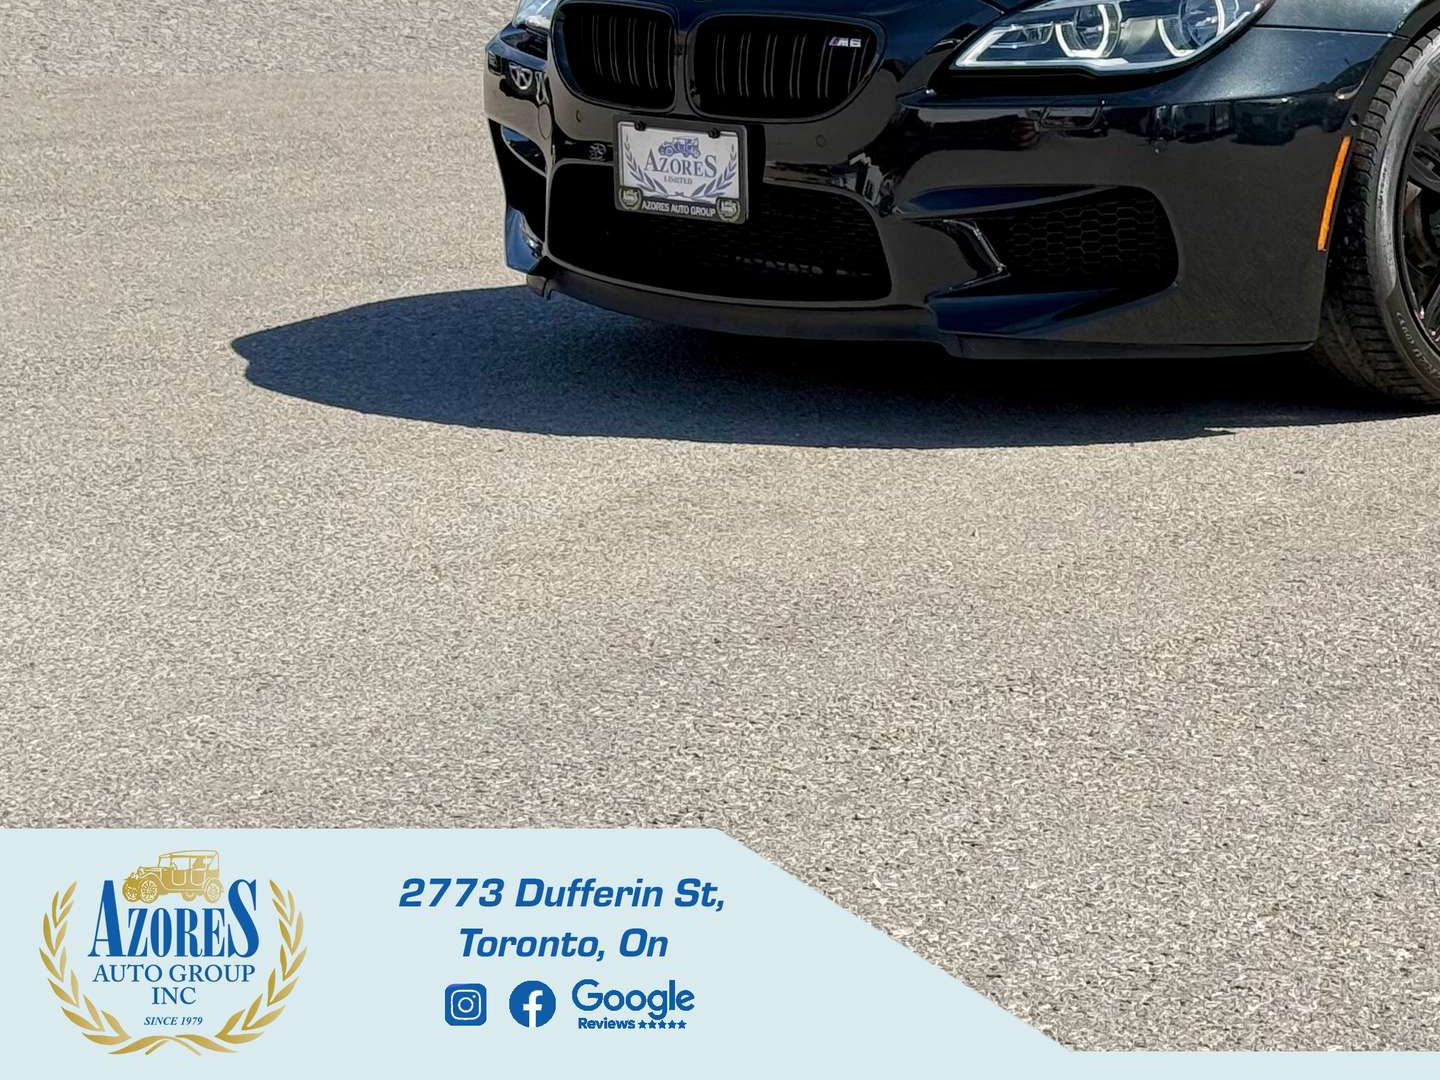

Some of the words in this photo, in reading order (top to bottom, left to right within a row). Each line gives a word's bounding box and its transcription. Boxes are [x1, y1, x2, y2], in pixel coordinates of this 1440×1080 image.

[644, 148, 718, 179] AZORES
[642, 200, 670, 213] AZORES
[671, 204, 690, 216] AUTO
[691, 206, 717, 218] GROUP
